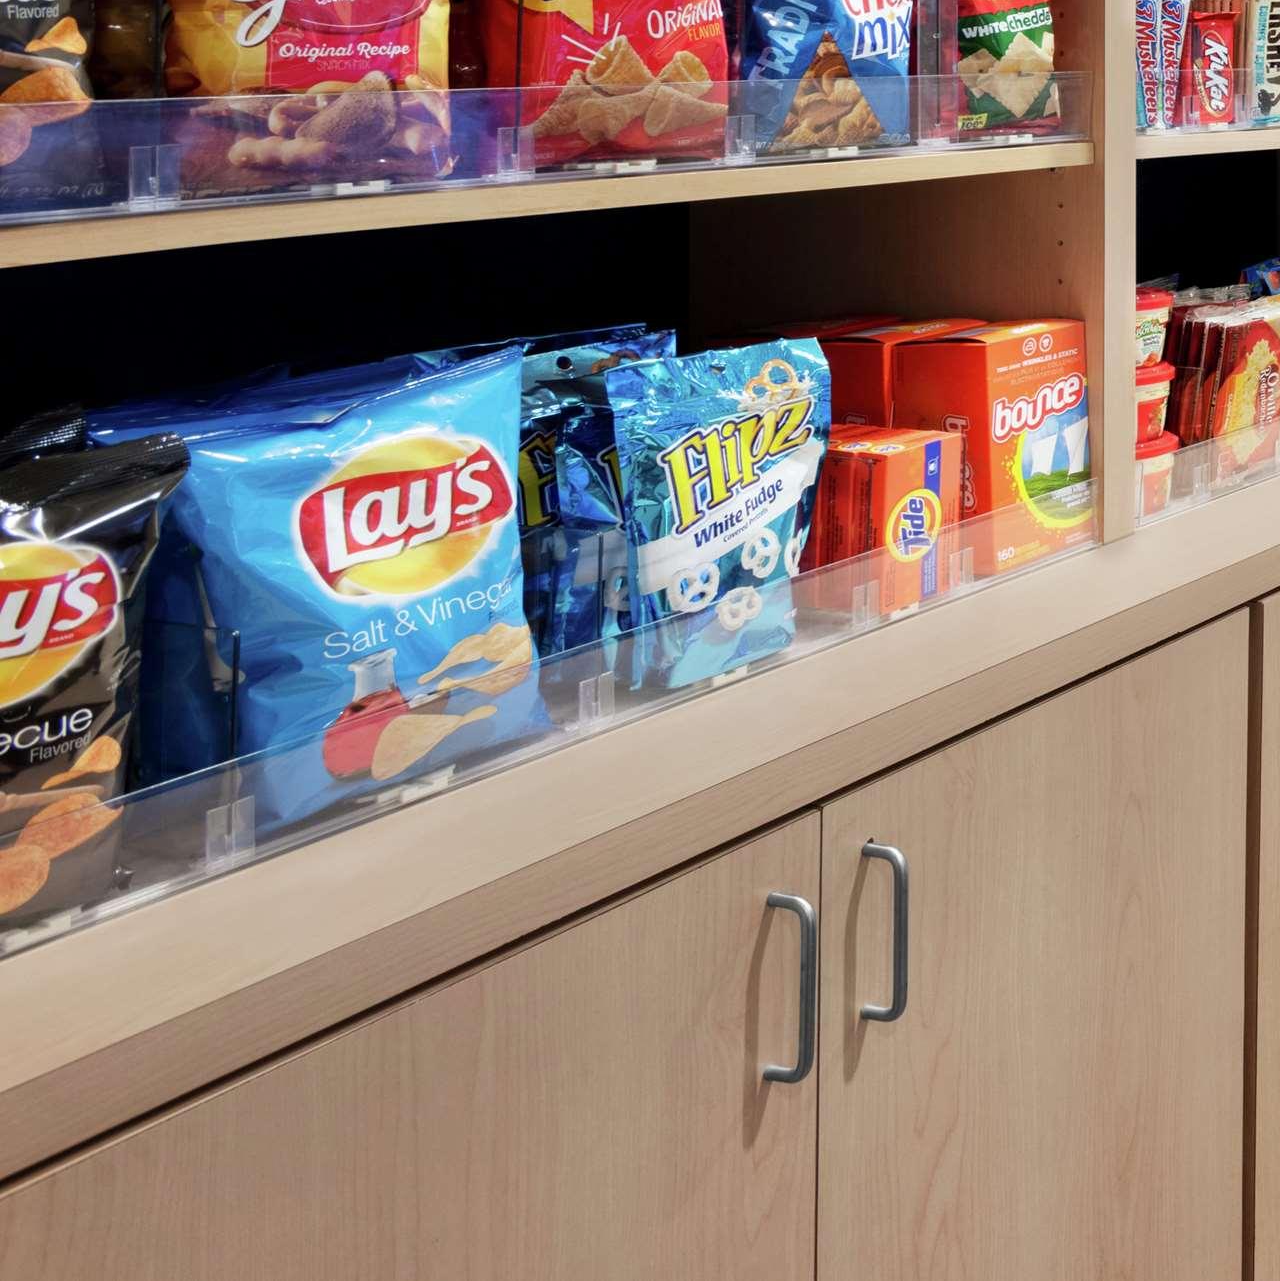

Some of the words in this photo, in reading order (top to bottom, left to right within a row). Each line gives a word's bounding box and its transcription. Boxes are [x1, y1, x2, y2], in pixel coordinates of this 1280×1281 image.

[7, 3, 60, 20] Flavored
[279, 42, 352, 63] Original
[356, 40, 411, 59] Recipe
[1161, 21, 1181, 123] Musketeers
[993, 373, 1084, 441] bounce
[1266, 364, 1280, 424] Orville
[661, 397, 812, 534] Flipz
[323, 457, 493, 573] Lay's
[694, 509, 743, 548] White
[744, 478, 783, 516] Fudge
[900, 496, 932, 556] Tide
[324, 618, 388, 659] Salt
[395, 610, 418, 636] &
[29, 732, 91, 764] Flavored
